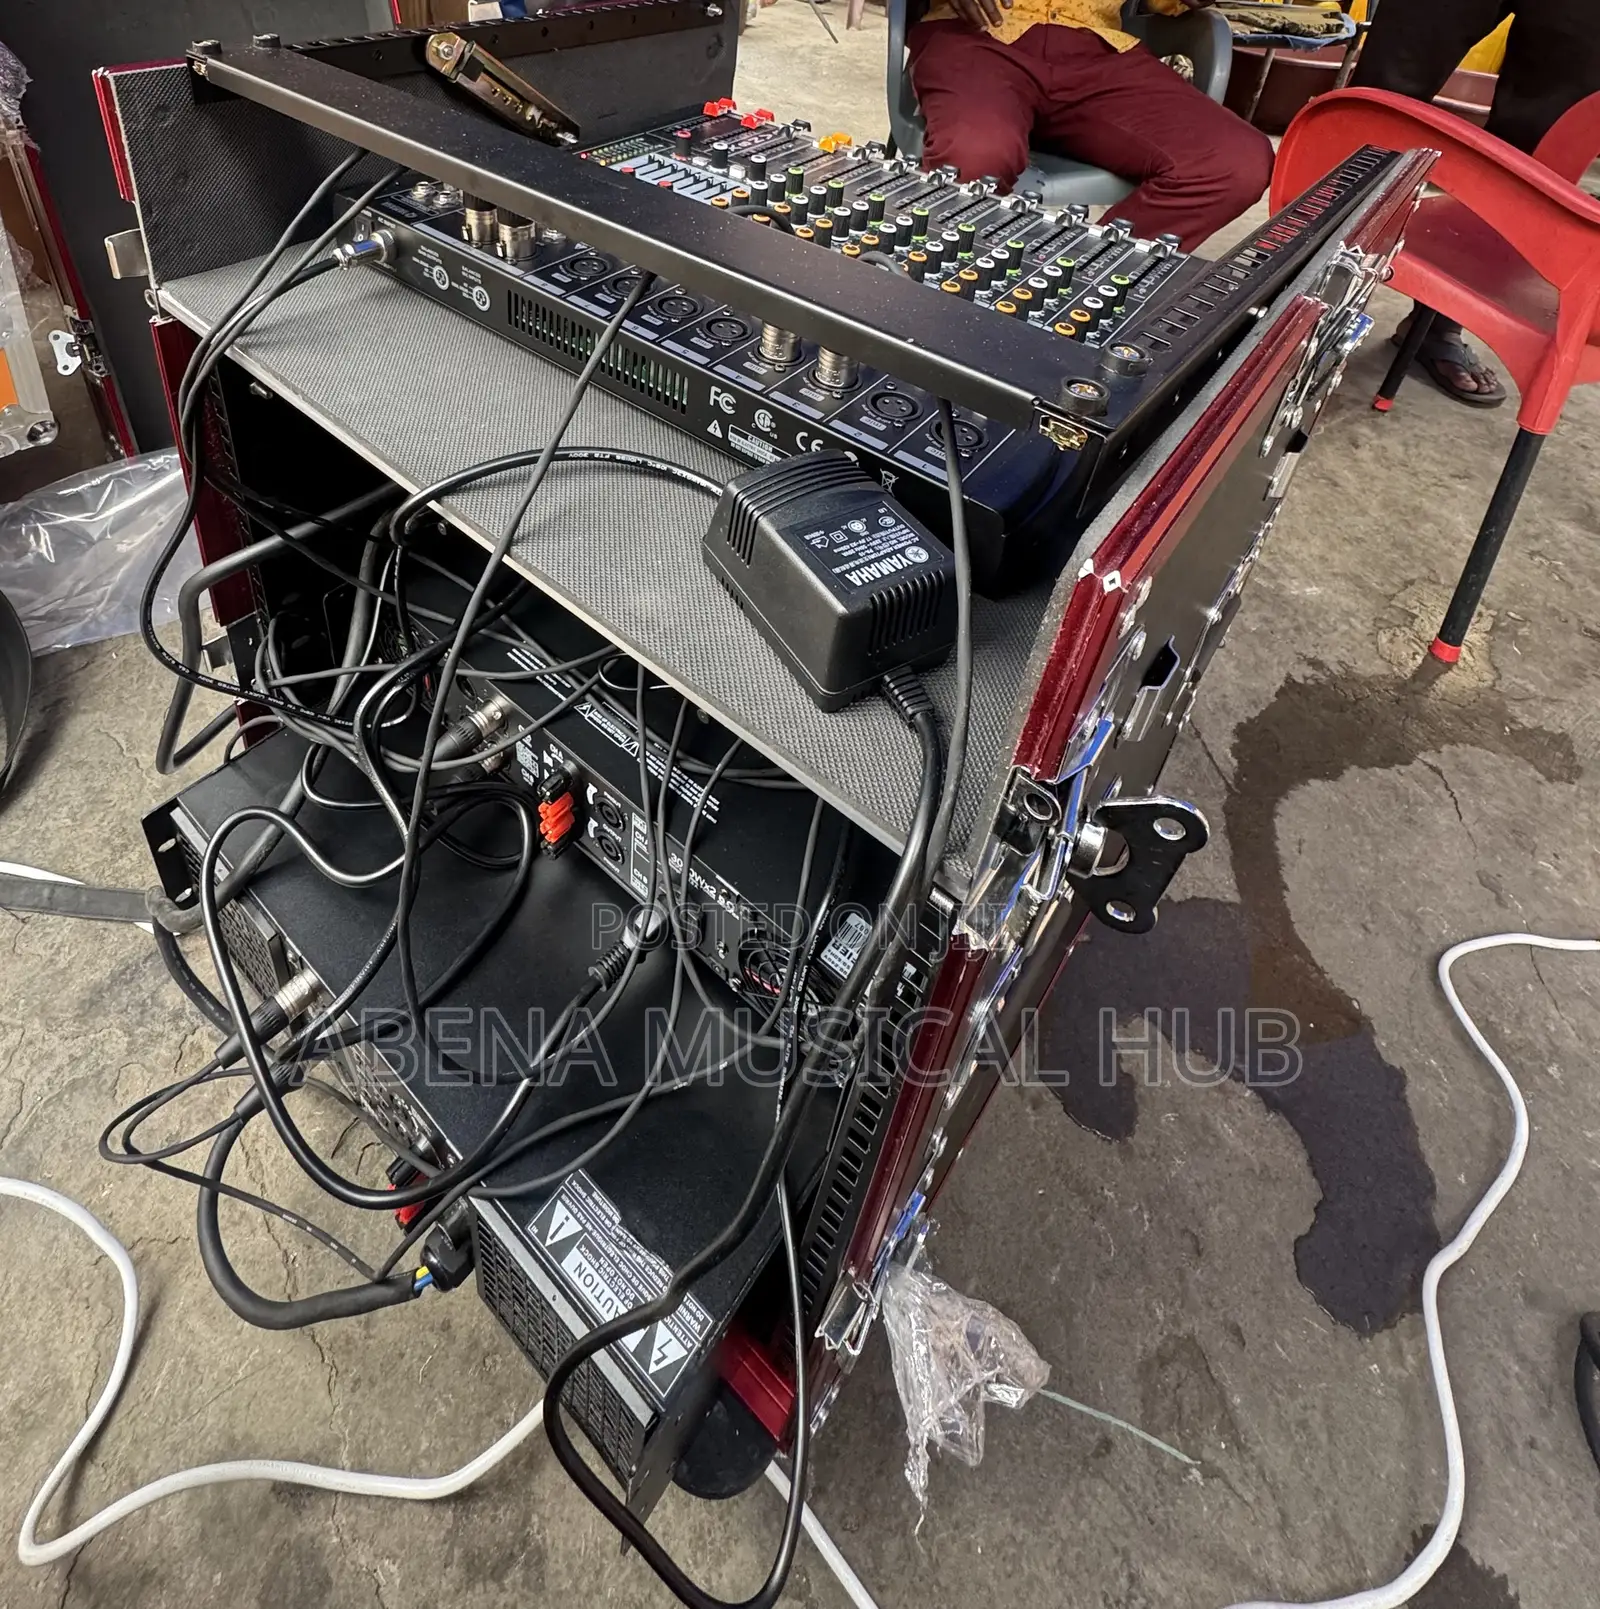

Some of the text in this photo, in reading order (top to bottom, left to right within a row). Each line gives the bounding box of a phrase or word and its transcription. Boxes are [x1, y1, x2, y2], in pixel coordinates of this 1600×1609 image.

[845, 553, 913, 586] YAMAHA
[579, 1243, 600, 1269] SHOCK
[617, 1259, 633, 1278] CHOC
[573, 1261, 622, 1319] AUTION
[597, 1265, 625, 1300] ELECTRIC
[598, 1256, 635, 1300] DO NOT OPEN
